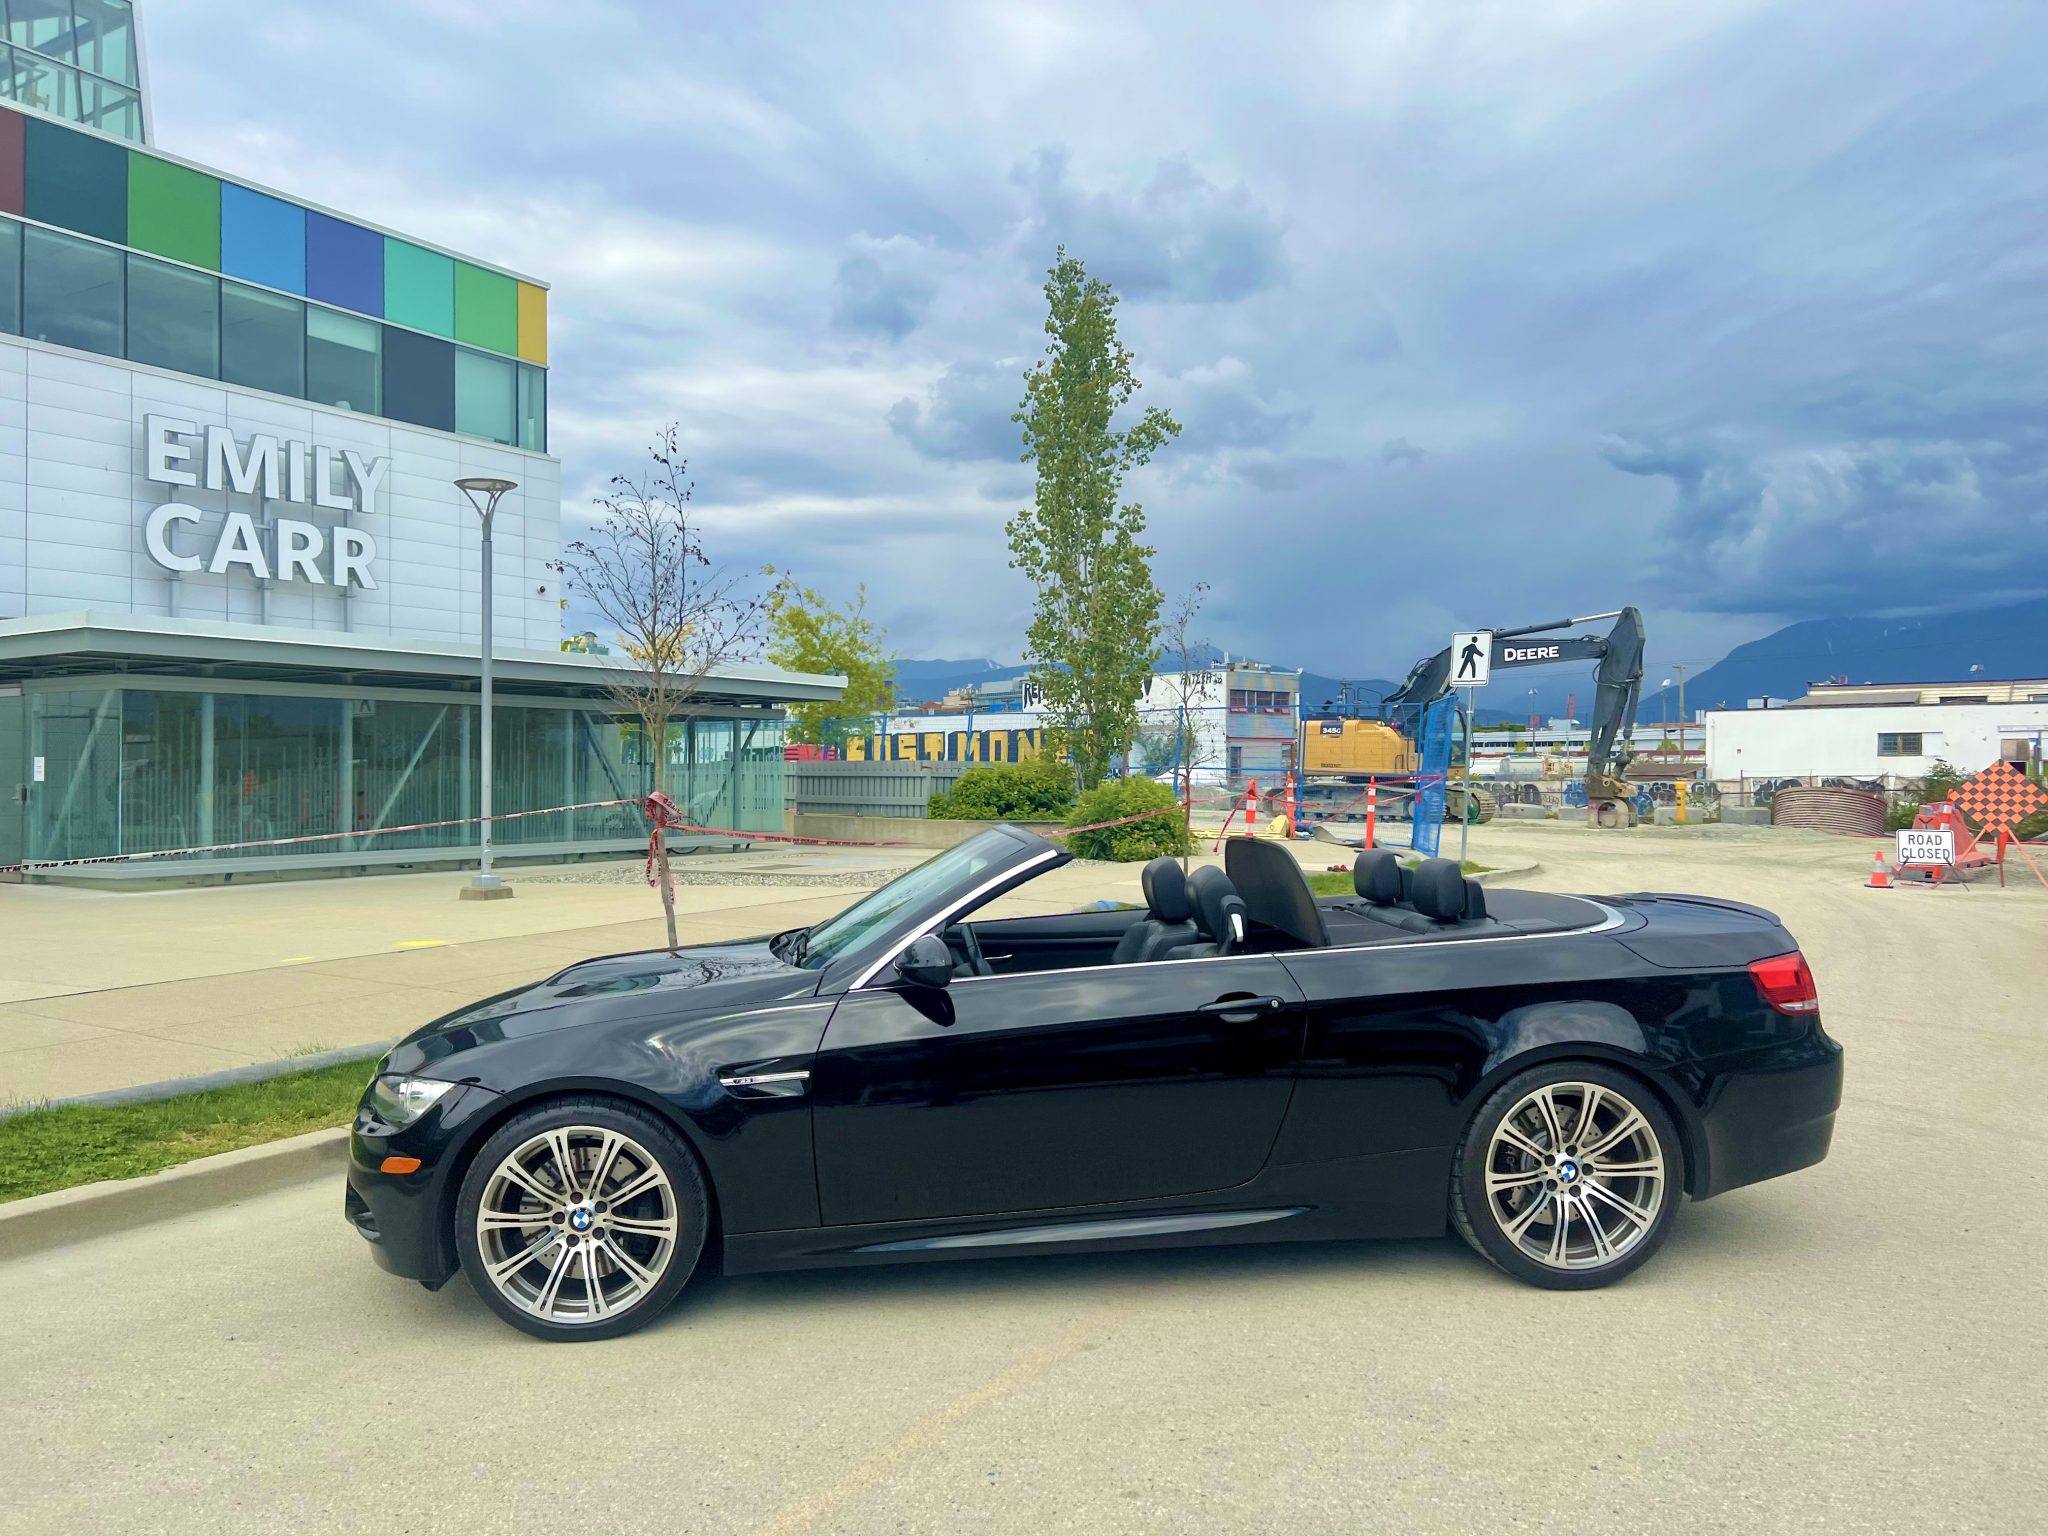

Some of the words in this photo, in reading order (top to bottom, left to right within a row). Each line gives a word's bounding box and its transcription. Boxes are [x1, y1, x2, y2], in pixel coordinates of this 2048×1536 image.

[143, 413, 392, 514] EMILY
[142, 502, 379, 590] CARR
[1503, 645, 1560, 662] DEERE
[1907, 834, 1943, 846] ROAD
[1901, 847, 1951, 860] CLOSED
